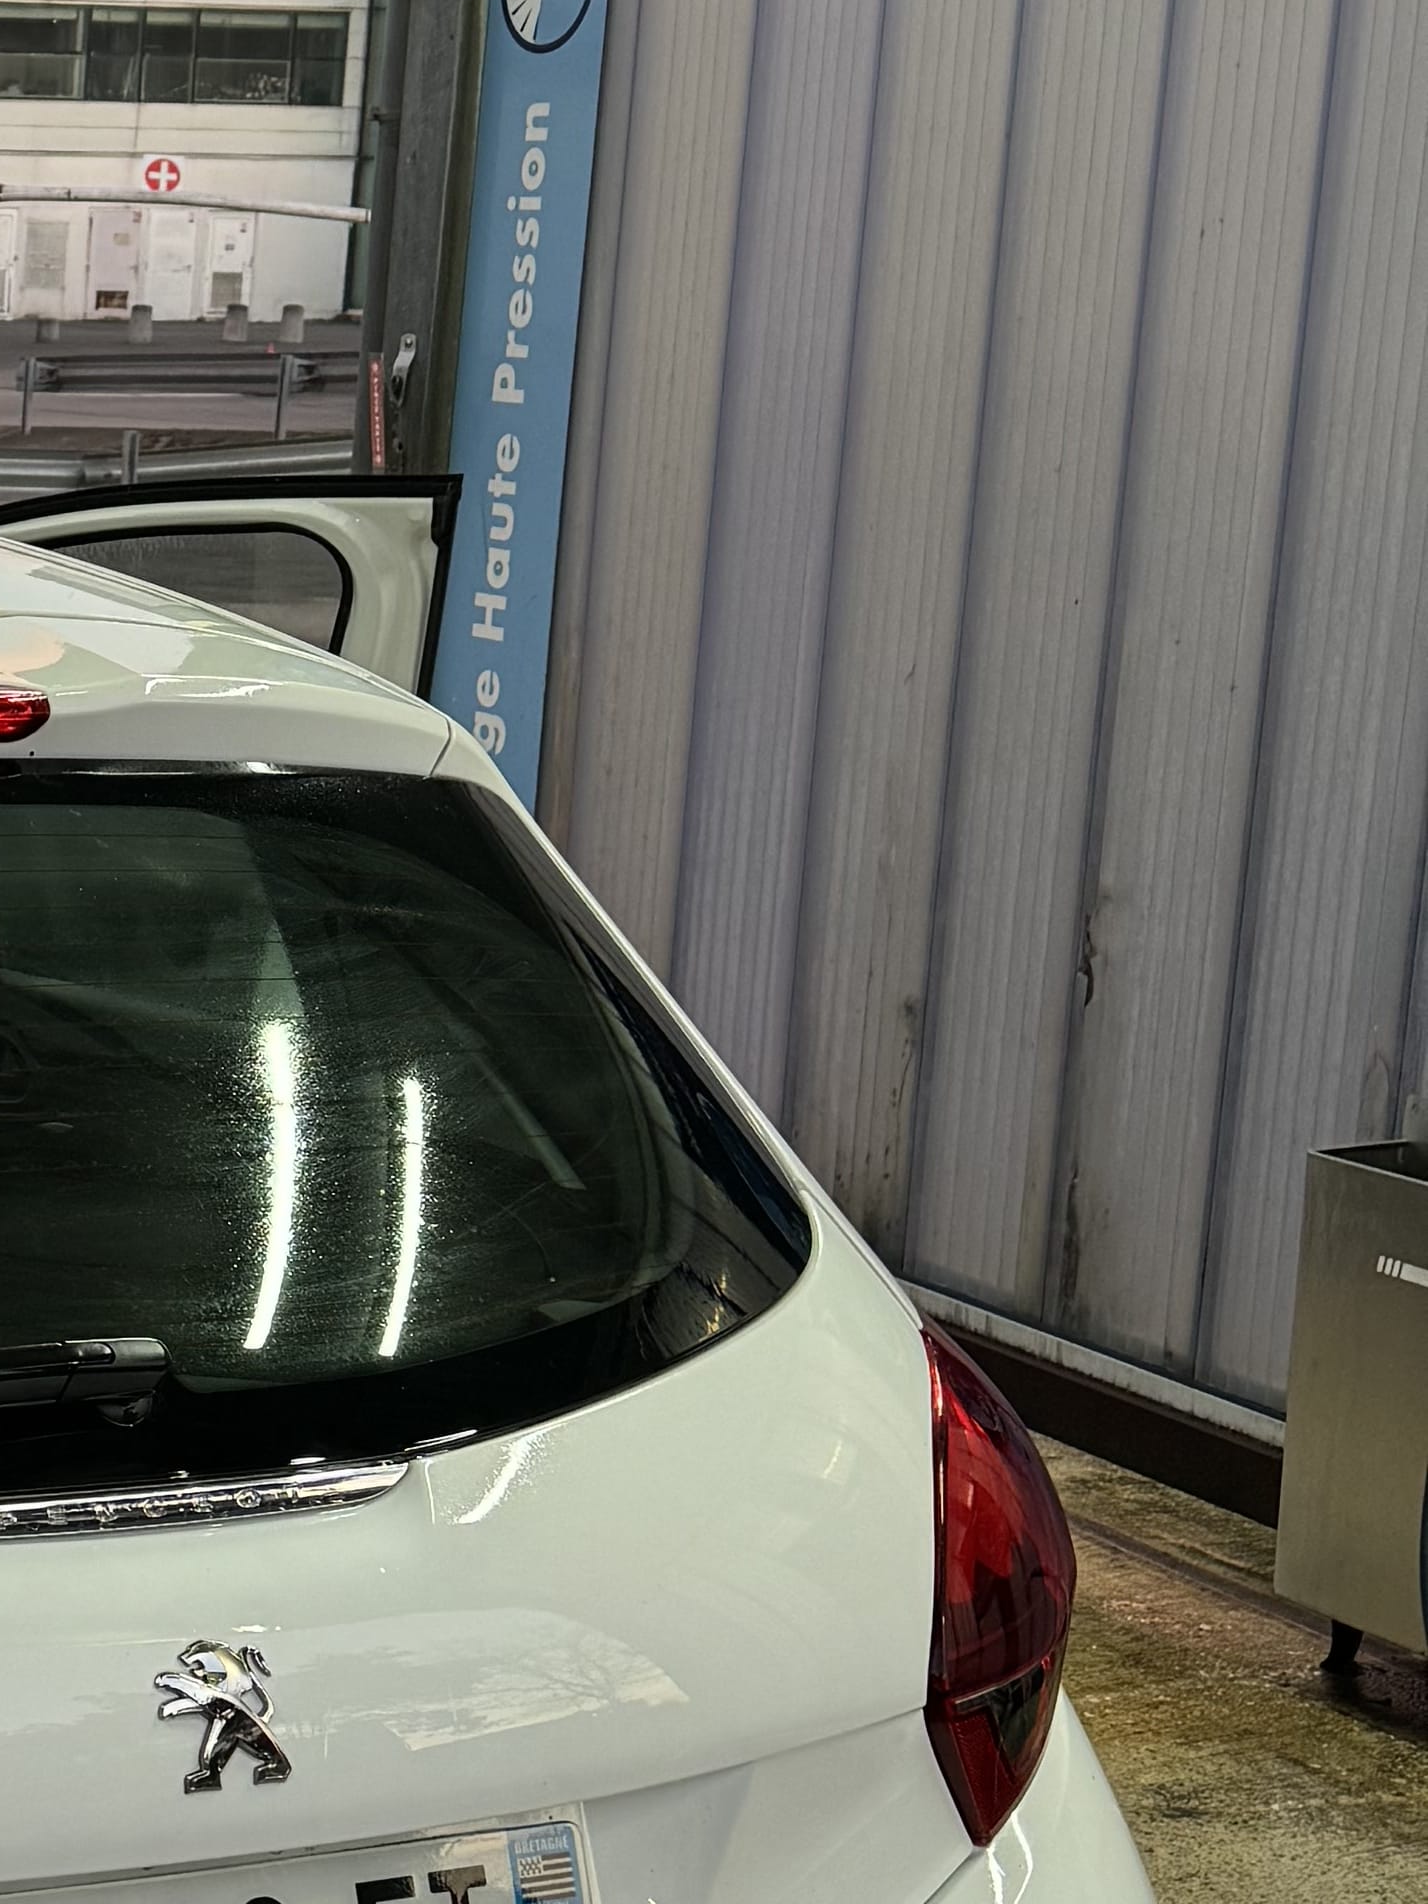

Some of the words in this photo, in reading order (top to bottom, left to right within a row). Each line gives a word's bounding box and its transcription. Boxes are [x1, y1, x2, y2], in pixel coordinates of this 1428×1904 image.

[491, 102, 551, 404] Pression
[472, 433, 520, 642] Haute
[513, 1836, 569, 1854] BRETAGNE
